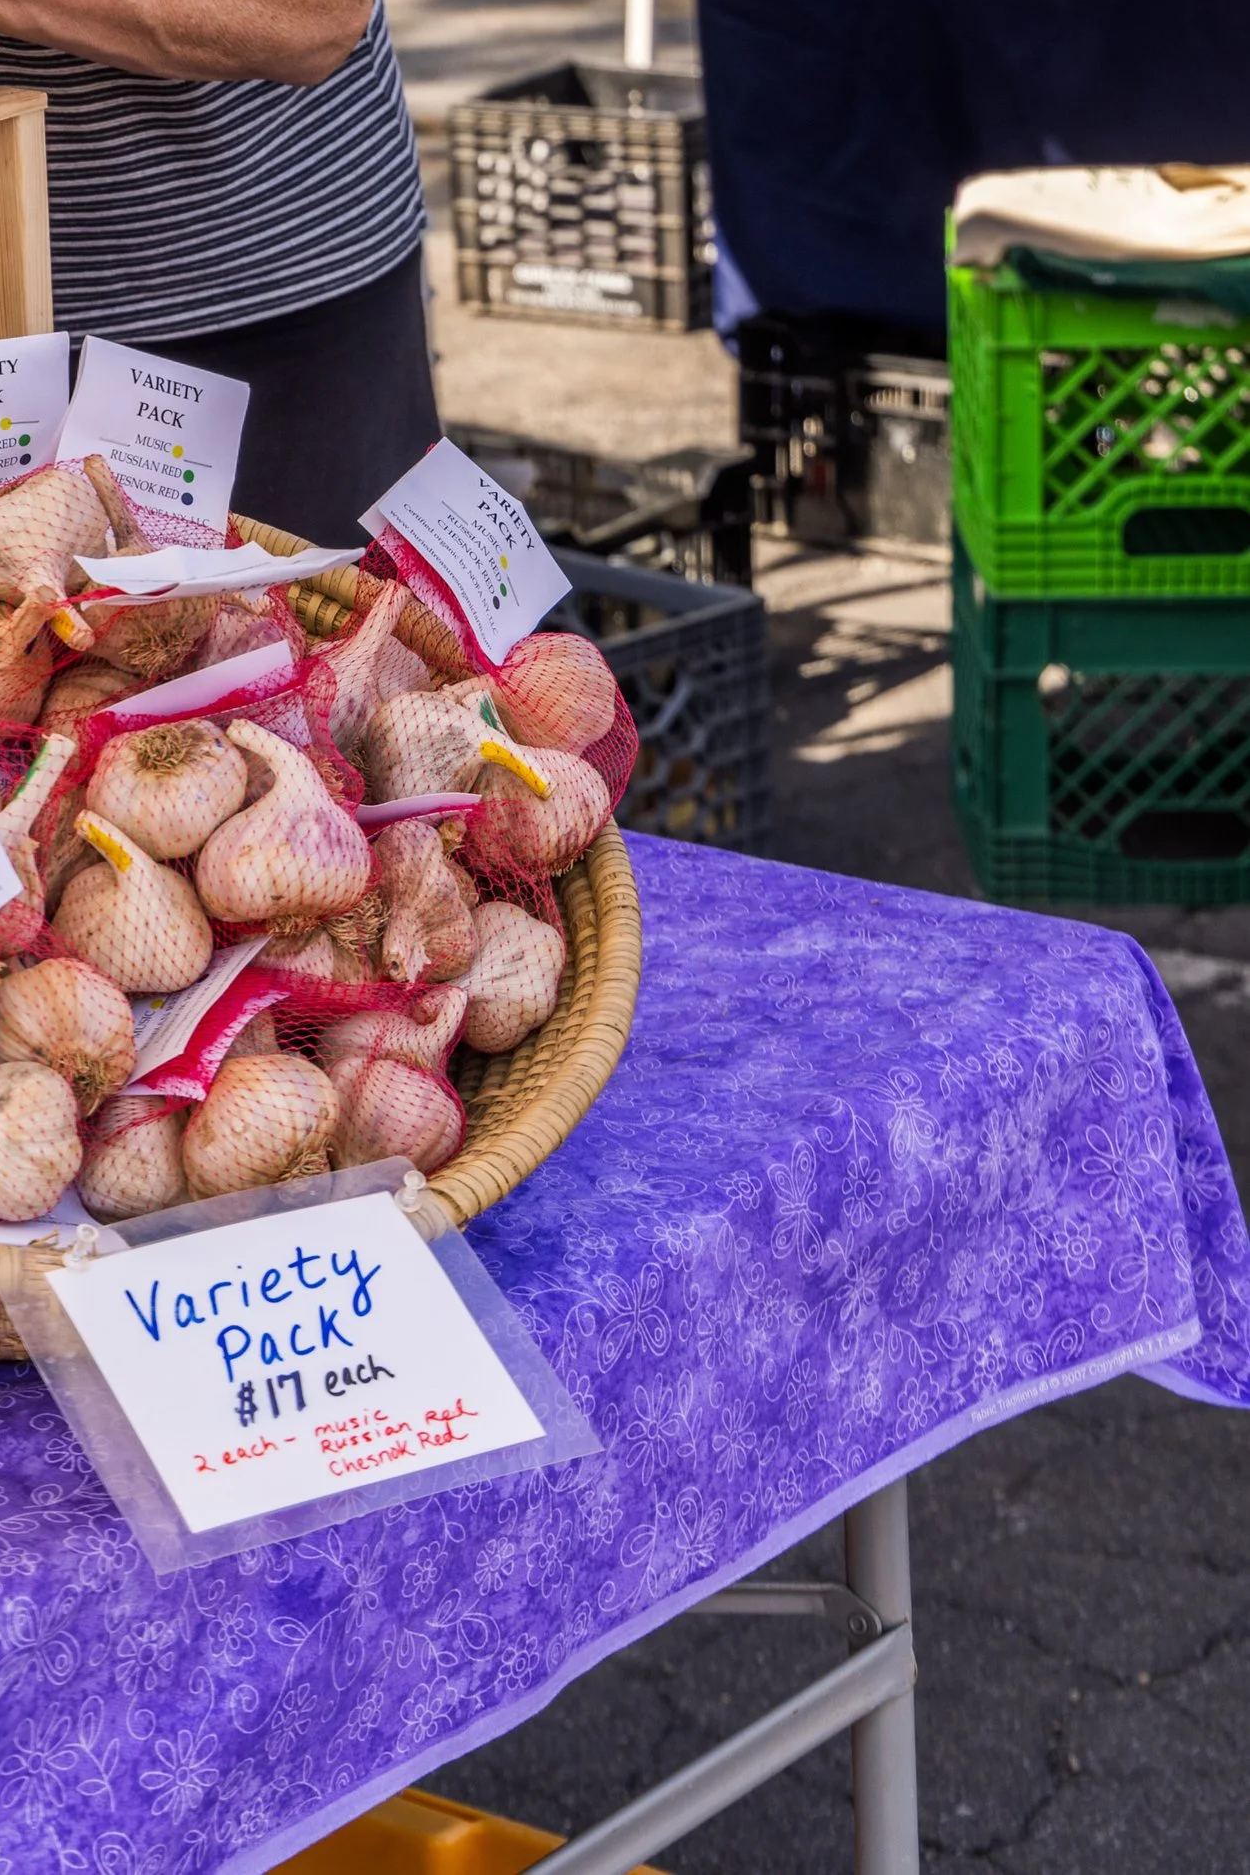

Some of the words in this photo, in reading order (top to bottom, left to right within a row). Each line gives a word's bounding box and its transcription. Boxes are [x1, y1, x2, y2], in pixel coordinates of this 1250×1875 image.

[130, 368, 204, 403] VARIETY
[135, 433, 173, 453] MUSIC
[137, 401, 185, 429] PACK
[110, 449, 161, 472] RUSSIAN
[160, 465, 183, 479] RED
[157, 485, 180, 500] RED
[403, 503, 436, 535] Certified
[433, 531, 460, 561] organic
[458, 559, 469, 570] by
[470, 519, 503, 552] MUSIC
[477, 501, 518, 551] PACK
[479, 477, 535, 551] VARIETY
[437, 519, 483, 570] CHESNOK
[481, 566, 496, 595] RED
[447, 514, 489, 559] RUSSIAN
[487, 555, 502, 582] RED
[124, 1246, 381, 1341] Variety
[216, 1305, 354, 1383] Pack
[234, 1370, 307, 1428] $17
[324, 1354, 395, 1397] each
[193, 1454, 216, 1472] 2
[314, 1408, 388, 1437] music
[320, 1421, 413, 1454] Russian
[424, 1397, 478, 1425] Red
[416, 1421, 469, 1450] Red
